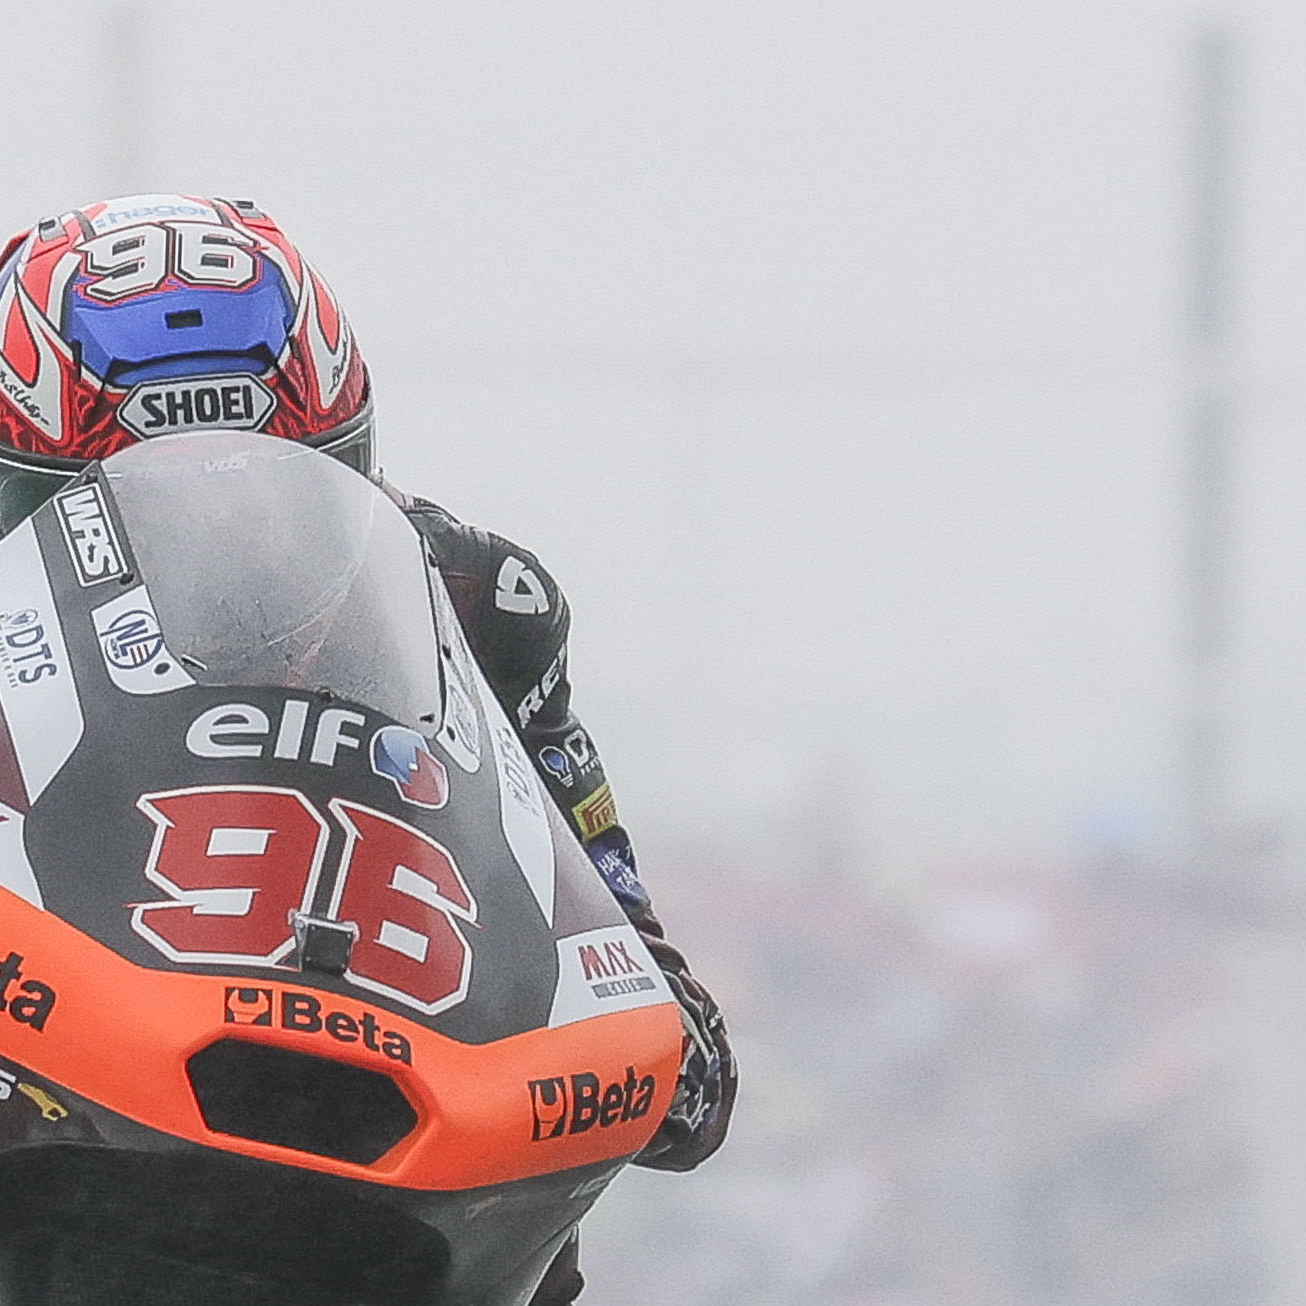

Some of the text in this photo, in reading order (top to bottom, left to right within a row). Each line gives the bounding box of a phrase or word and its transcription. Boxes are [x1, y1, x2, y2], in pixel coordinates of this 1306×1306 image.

[75, 221, 260, 303] 96
[141, 385, 254, 428] SHOEI
[61, 488, 120, 576] WRS
[5, 624, 57, 684] DTS
[186, 700, 365, 766] elf
[129, 784, 482, 1016] 96
[578, 940, 645, 981] MAX
[281, 991, 413, 1067] Beta
[569, 1065, 655, 1136] Beta
